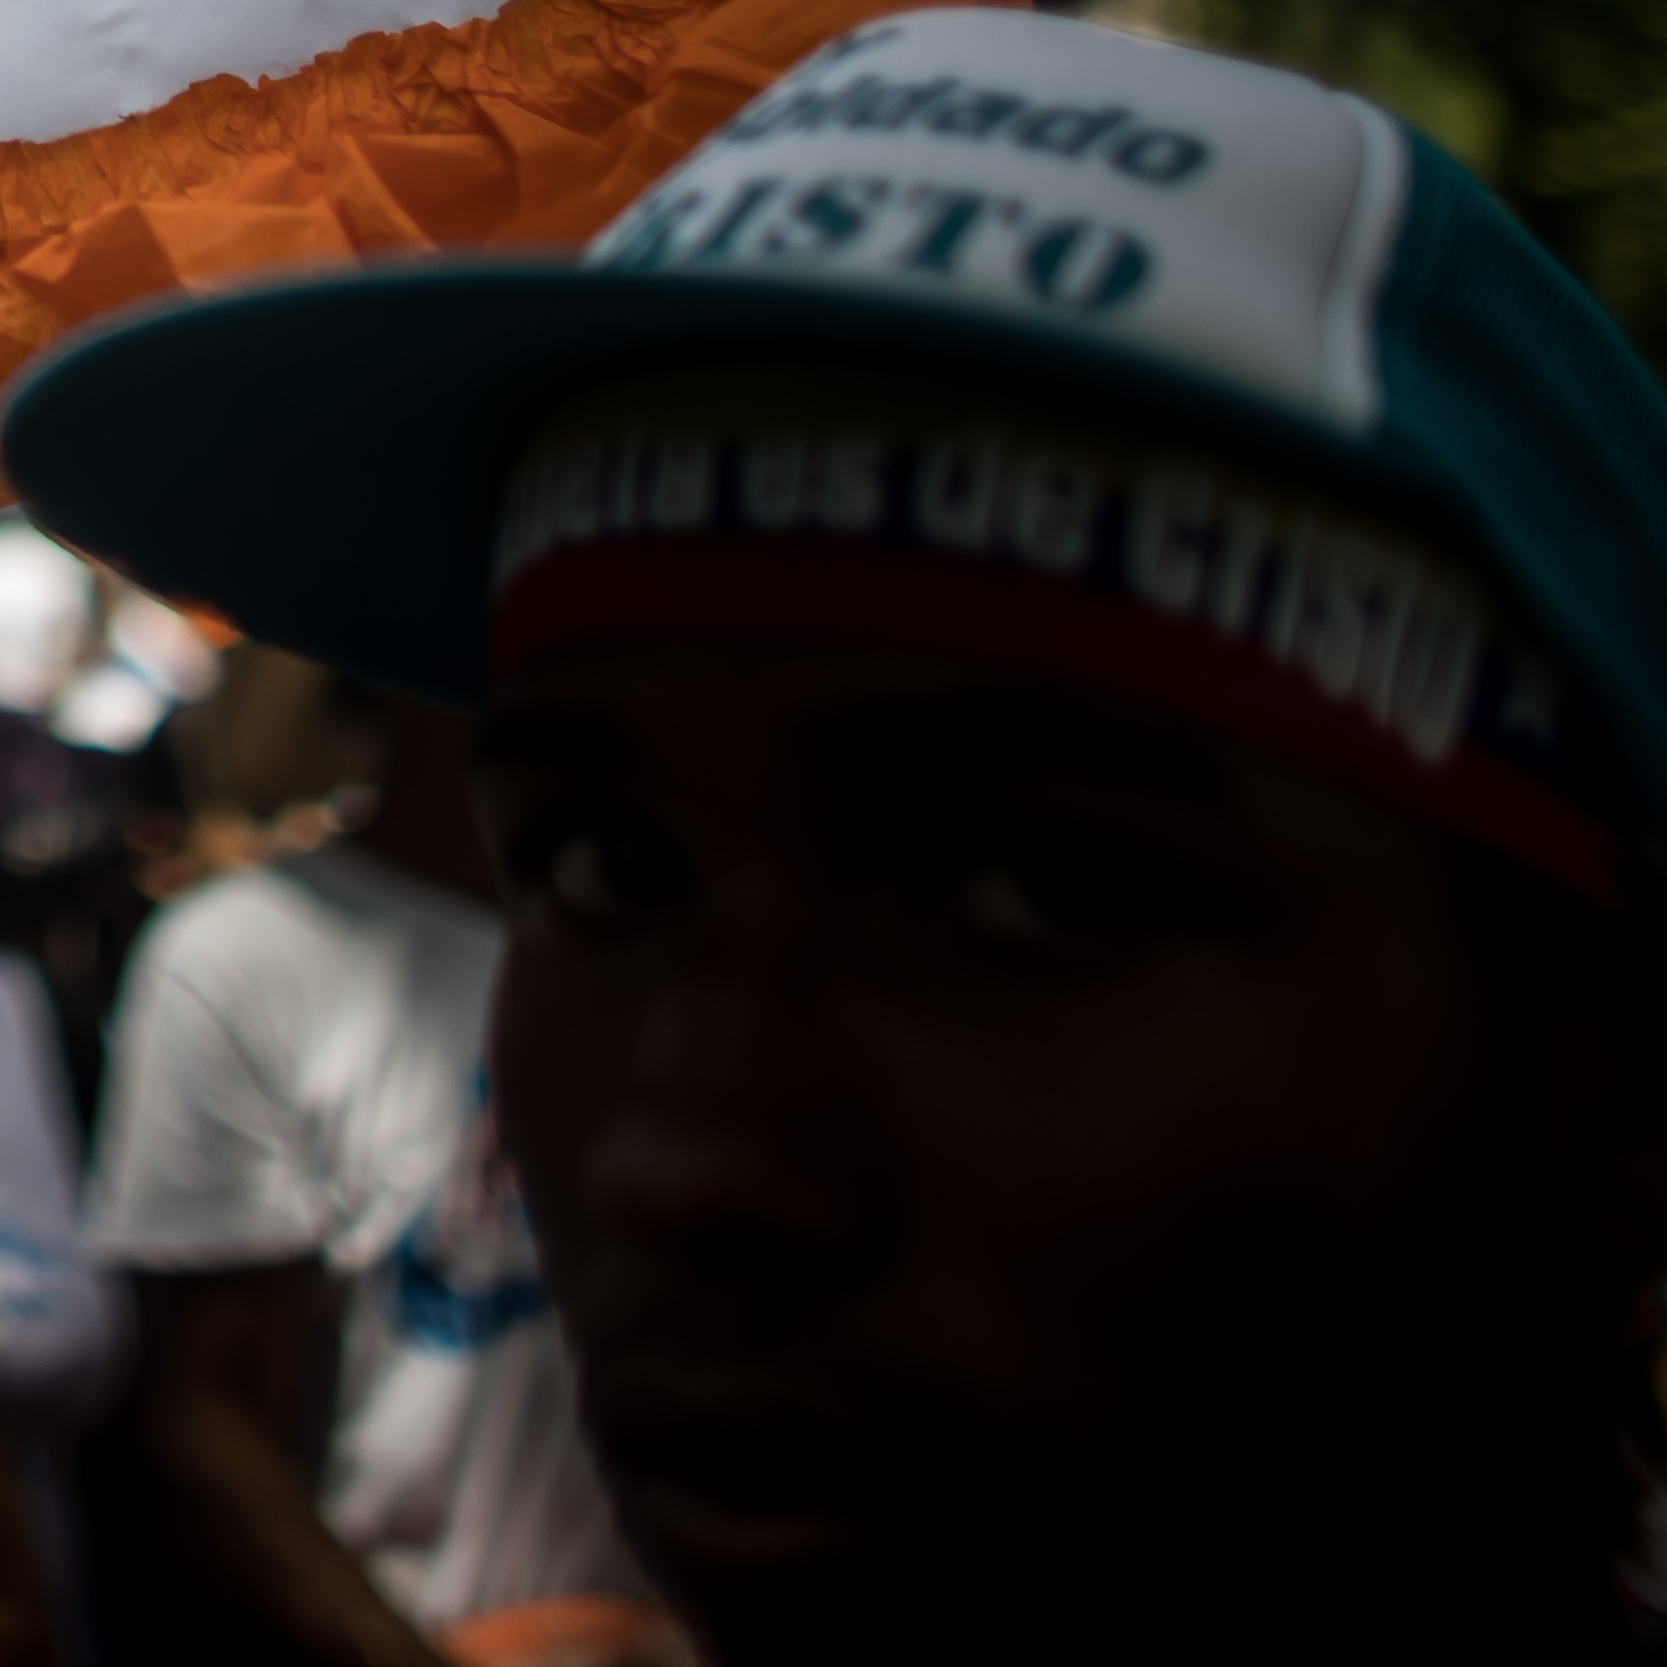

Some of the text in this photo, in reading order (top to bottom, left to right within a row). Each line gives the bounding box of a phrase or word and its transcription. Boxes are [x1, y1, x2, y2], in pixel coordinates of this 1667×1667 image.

[717, 72, 1213, 192] oldado
[731, 424, 895, 542] es
[905, 419, 1117, 584] de
